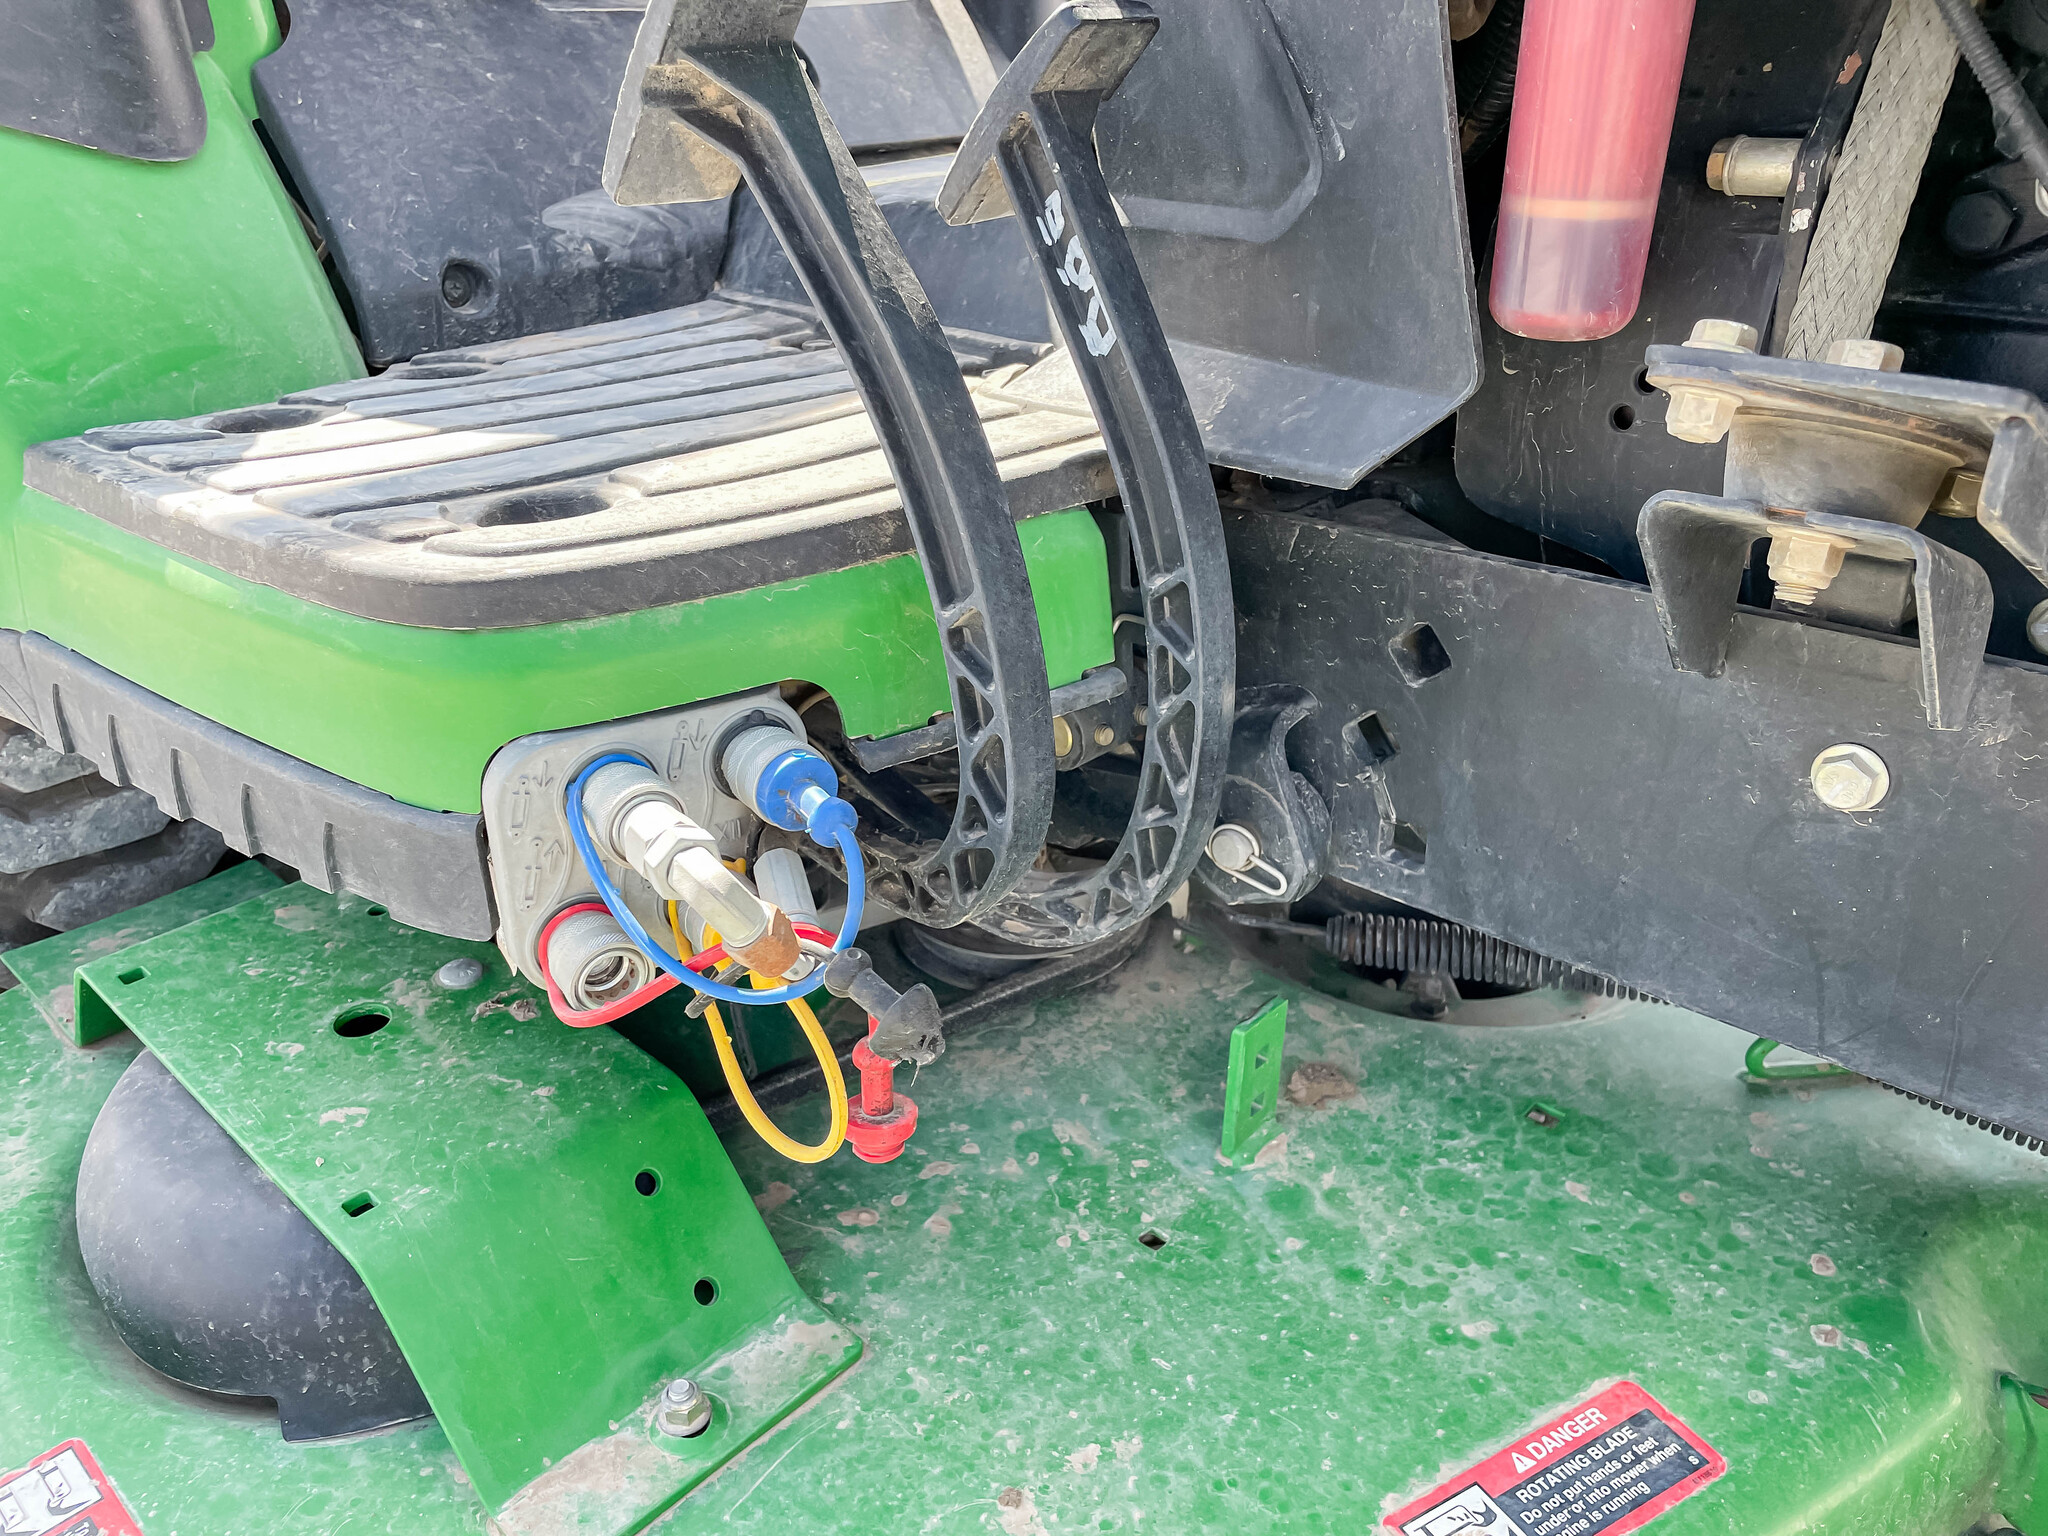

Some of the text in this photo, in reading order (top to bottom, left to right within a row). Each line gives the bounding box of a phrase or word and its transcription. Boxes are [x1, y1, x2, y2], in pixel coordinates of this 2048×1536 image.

[1515, 1426, 1638, 1504] ROTATING BLADE
[1525, 1407, 1608, 1460] DANGER
[1519, 1435, 1660, 1525] Do not put hands or feet
[1533, 1442, 1682, 1536] under or into mower when
[1585, 1510, 1604, 1523] is
[1600, 1481, 1651, 1515] running
